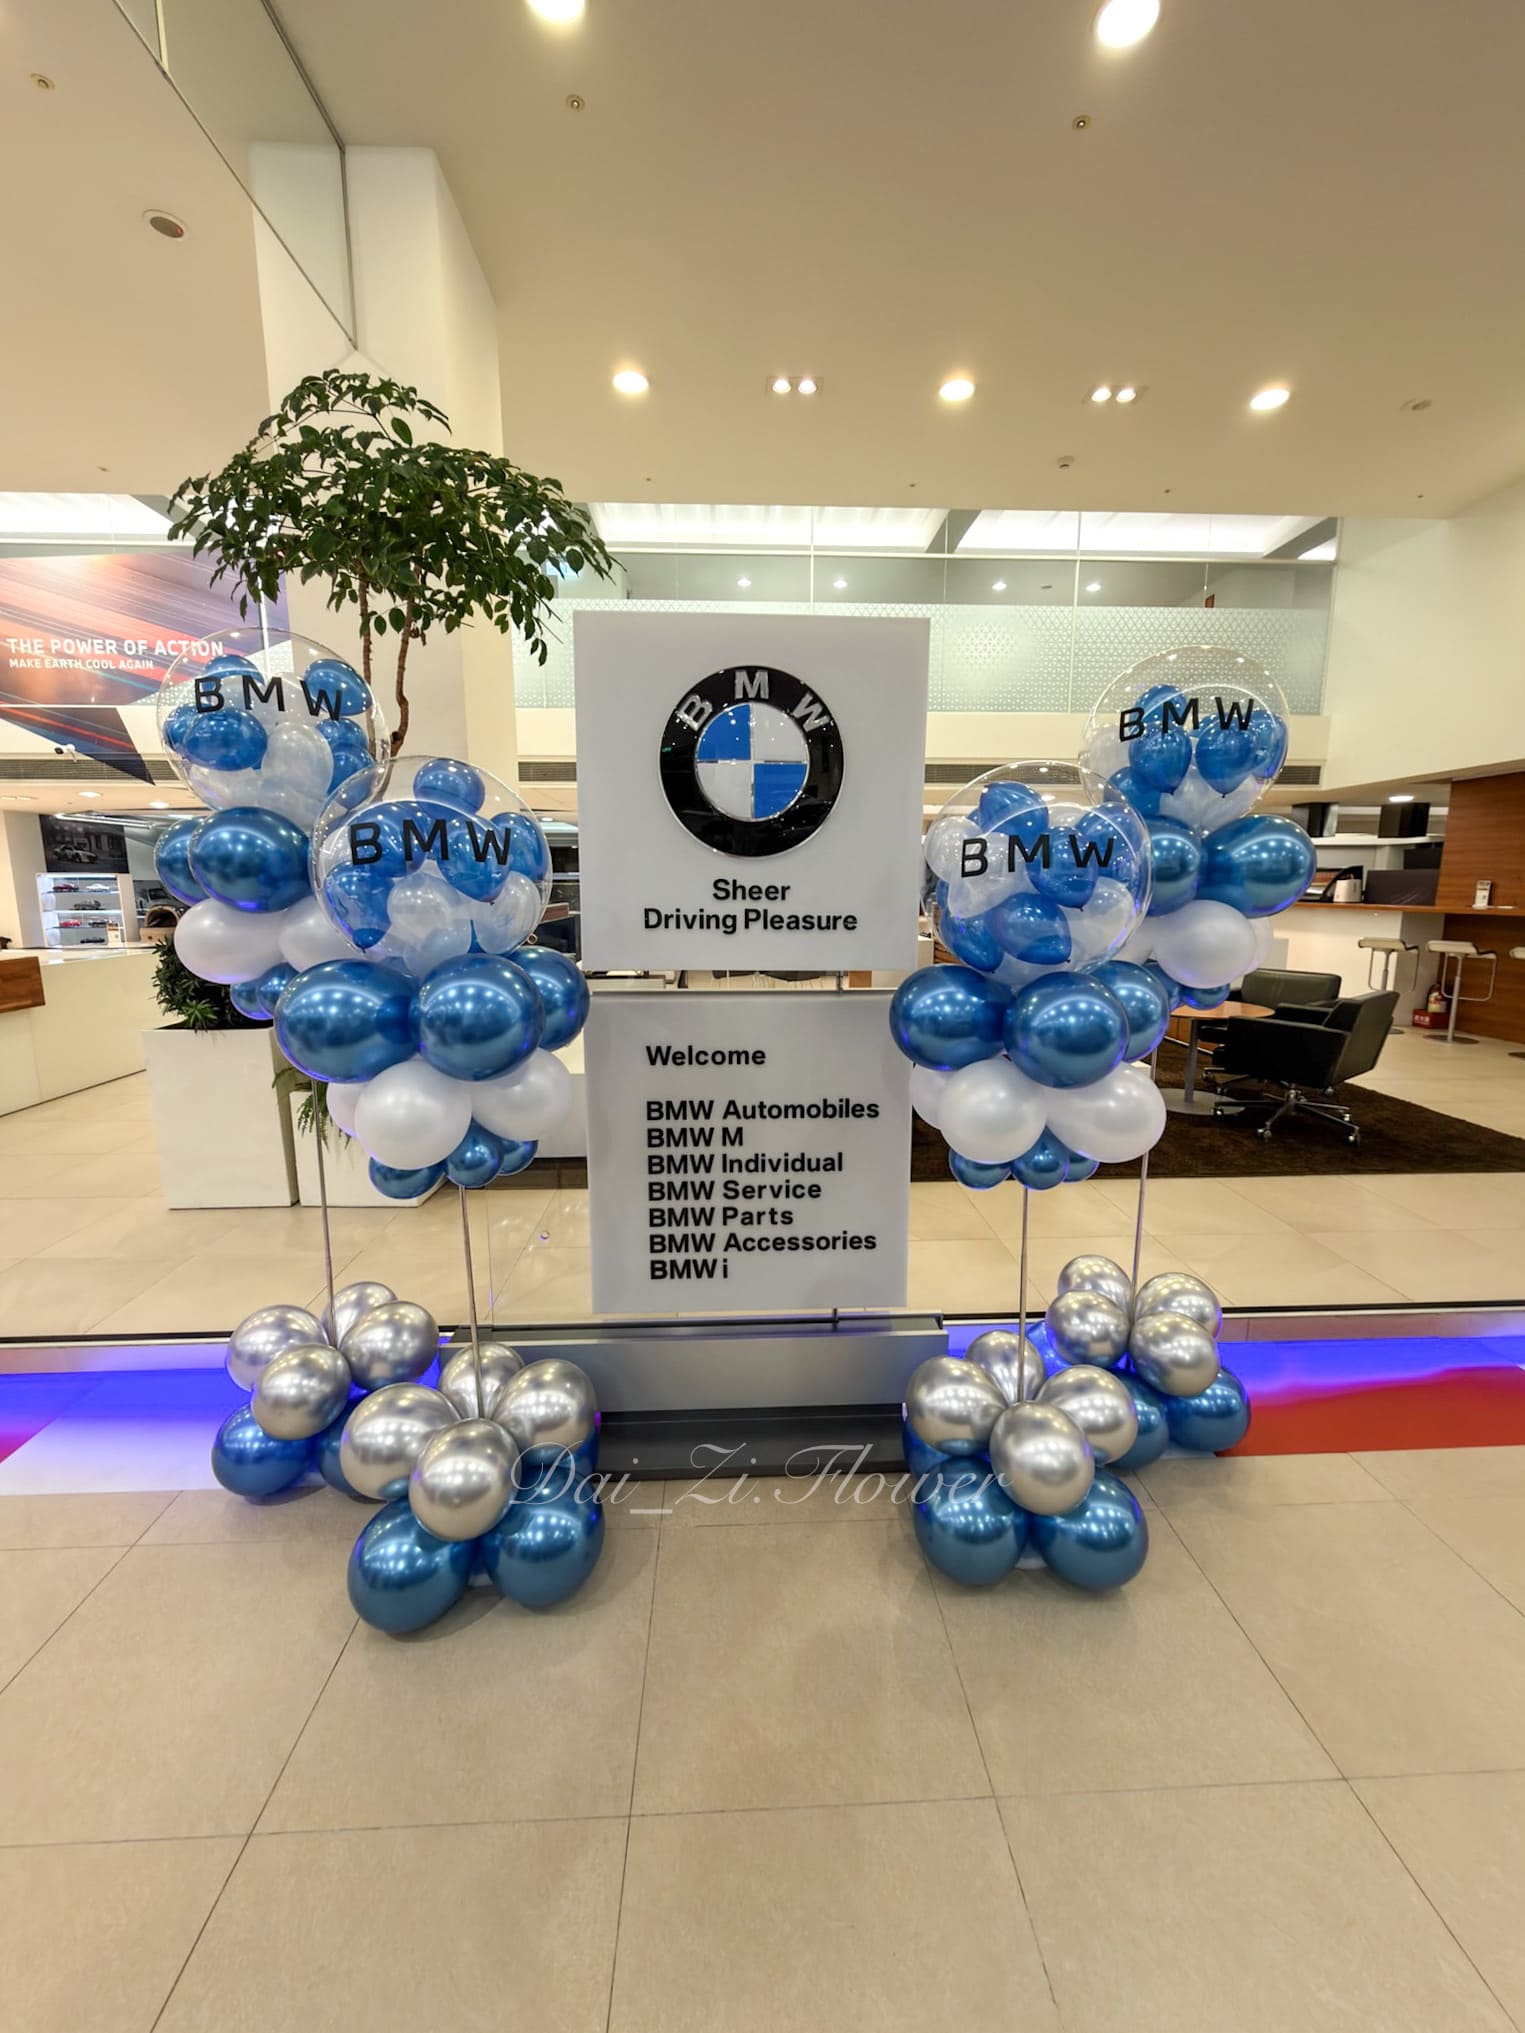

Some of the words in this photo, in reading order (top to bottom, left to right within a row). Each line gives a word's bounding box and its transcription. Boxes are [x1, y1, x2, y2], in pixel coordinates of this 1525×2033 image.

[6, 638, 44, 655] THE
[51, 639, 118, 656] POWER
[124, 640, 147, 656] OF
[155, 640, 224, 657] ACTION
[9, 658, 41, 669] MAKE
[45, 658, 82, 669] EARTH
[86, 659, 115, 669] COOL
[119, 659, 154, 670] AGAIN
[194, 675, 343, 721] BMW
[676, 670, 832, 733] BMW
[1118, 696, 1255, 743] BMW
[350, 818, 512, 867] BMW
[960, 834, 1115, 878] BMW
[712, 878, 791, 901] Sheer
[644, 908, 737, 935] Driving
[744, 908, 858, 931] Pleasure
[645, 1045, 766, 1066] Welcome
[646, 1100, 714, 1121] BMW
[722, 1098, 880, 1120] Automobiles
[647, 1127, 714, 1148] BMW
[722, 1127, 743, 1147] M
[647, 1154, 715, 1175] BMW
[722, 1152, 843, 1173] Individual
[648, 1181, 715, 1201] BMW
[722, 1179, 822, 1199] Service
[649, 1207, 715, 1228] BMW
[722, 1206, 794, 1226] Parts
[649, 1233, 716, 1254] BMW
[723, 1230, 877, 1252] Accessories
[650, 1259, 718, 1280] BMW
[722, 1258, 728, 1279] i
